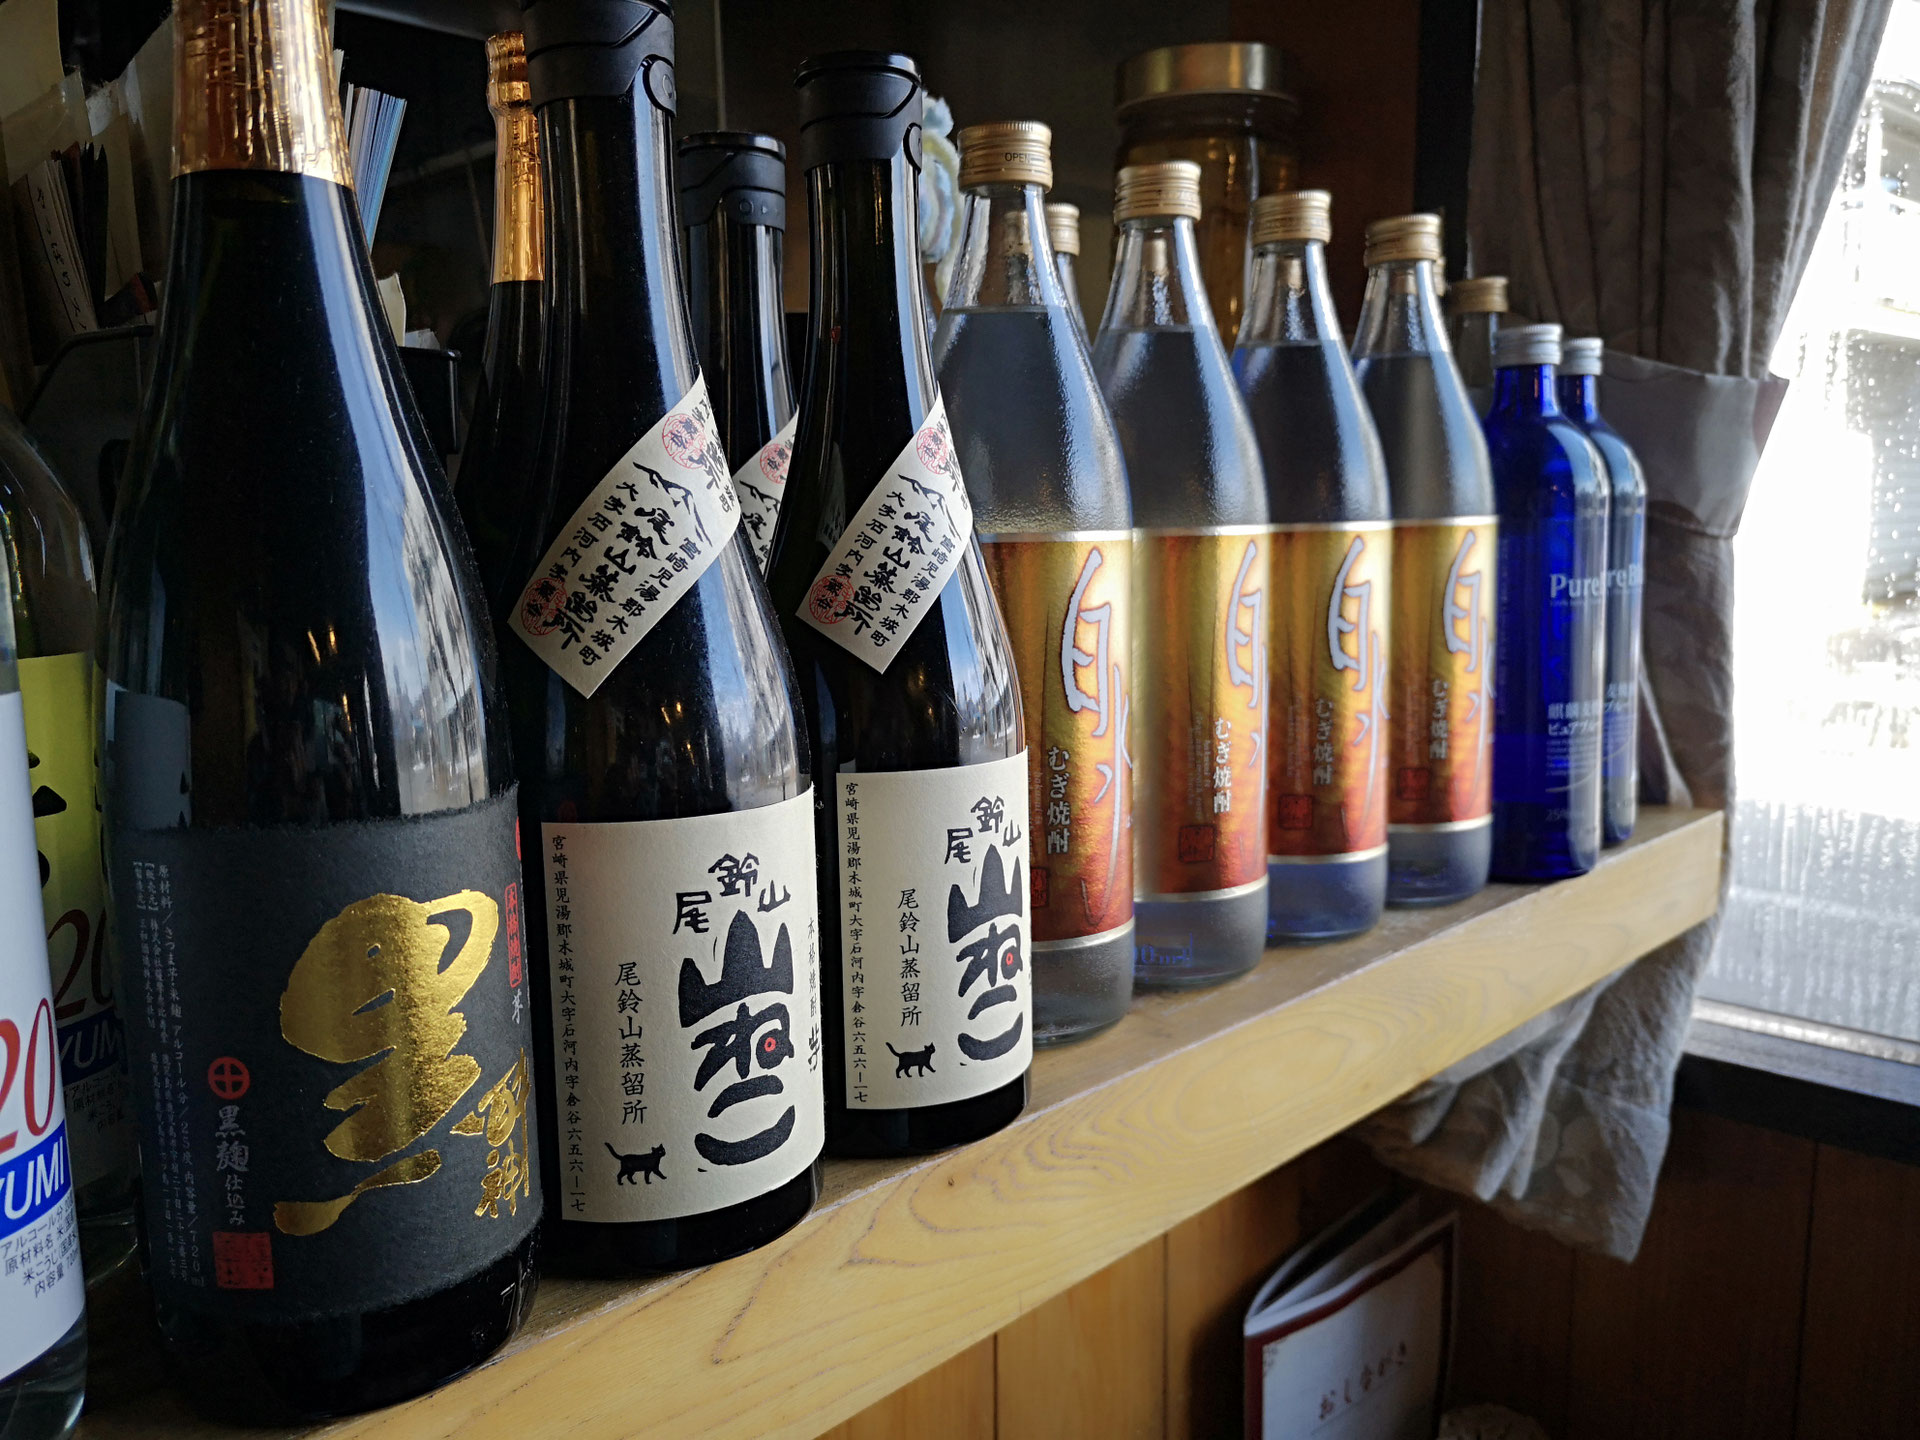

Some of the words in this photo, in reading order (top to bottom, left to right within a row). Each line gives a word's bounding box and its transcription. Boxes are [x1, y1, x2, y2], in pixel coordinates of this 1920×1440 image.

[1048, 746, 1070, 854] むぎ焼酎
[1214, 717, 1232, 814] むぎ焼酎
[945, 796, 1022, 864] 尾鈴山
[673, 852, 791, 935] 尾鈴山
[947, 843, 1023, 1062] 山ねこ
[897, 888, 922, 1028] 尾鈴山蒸留所
[614, 960, 648, 1126] 尾鈴山蒸留所
[678, 909, 796, 1167] 山ねこ
